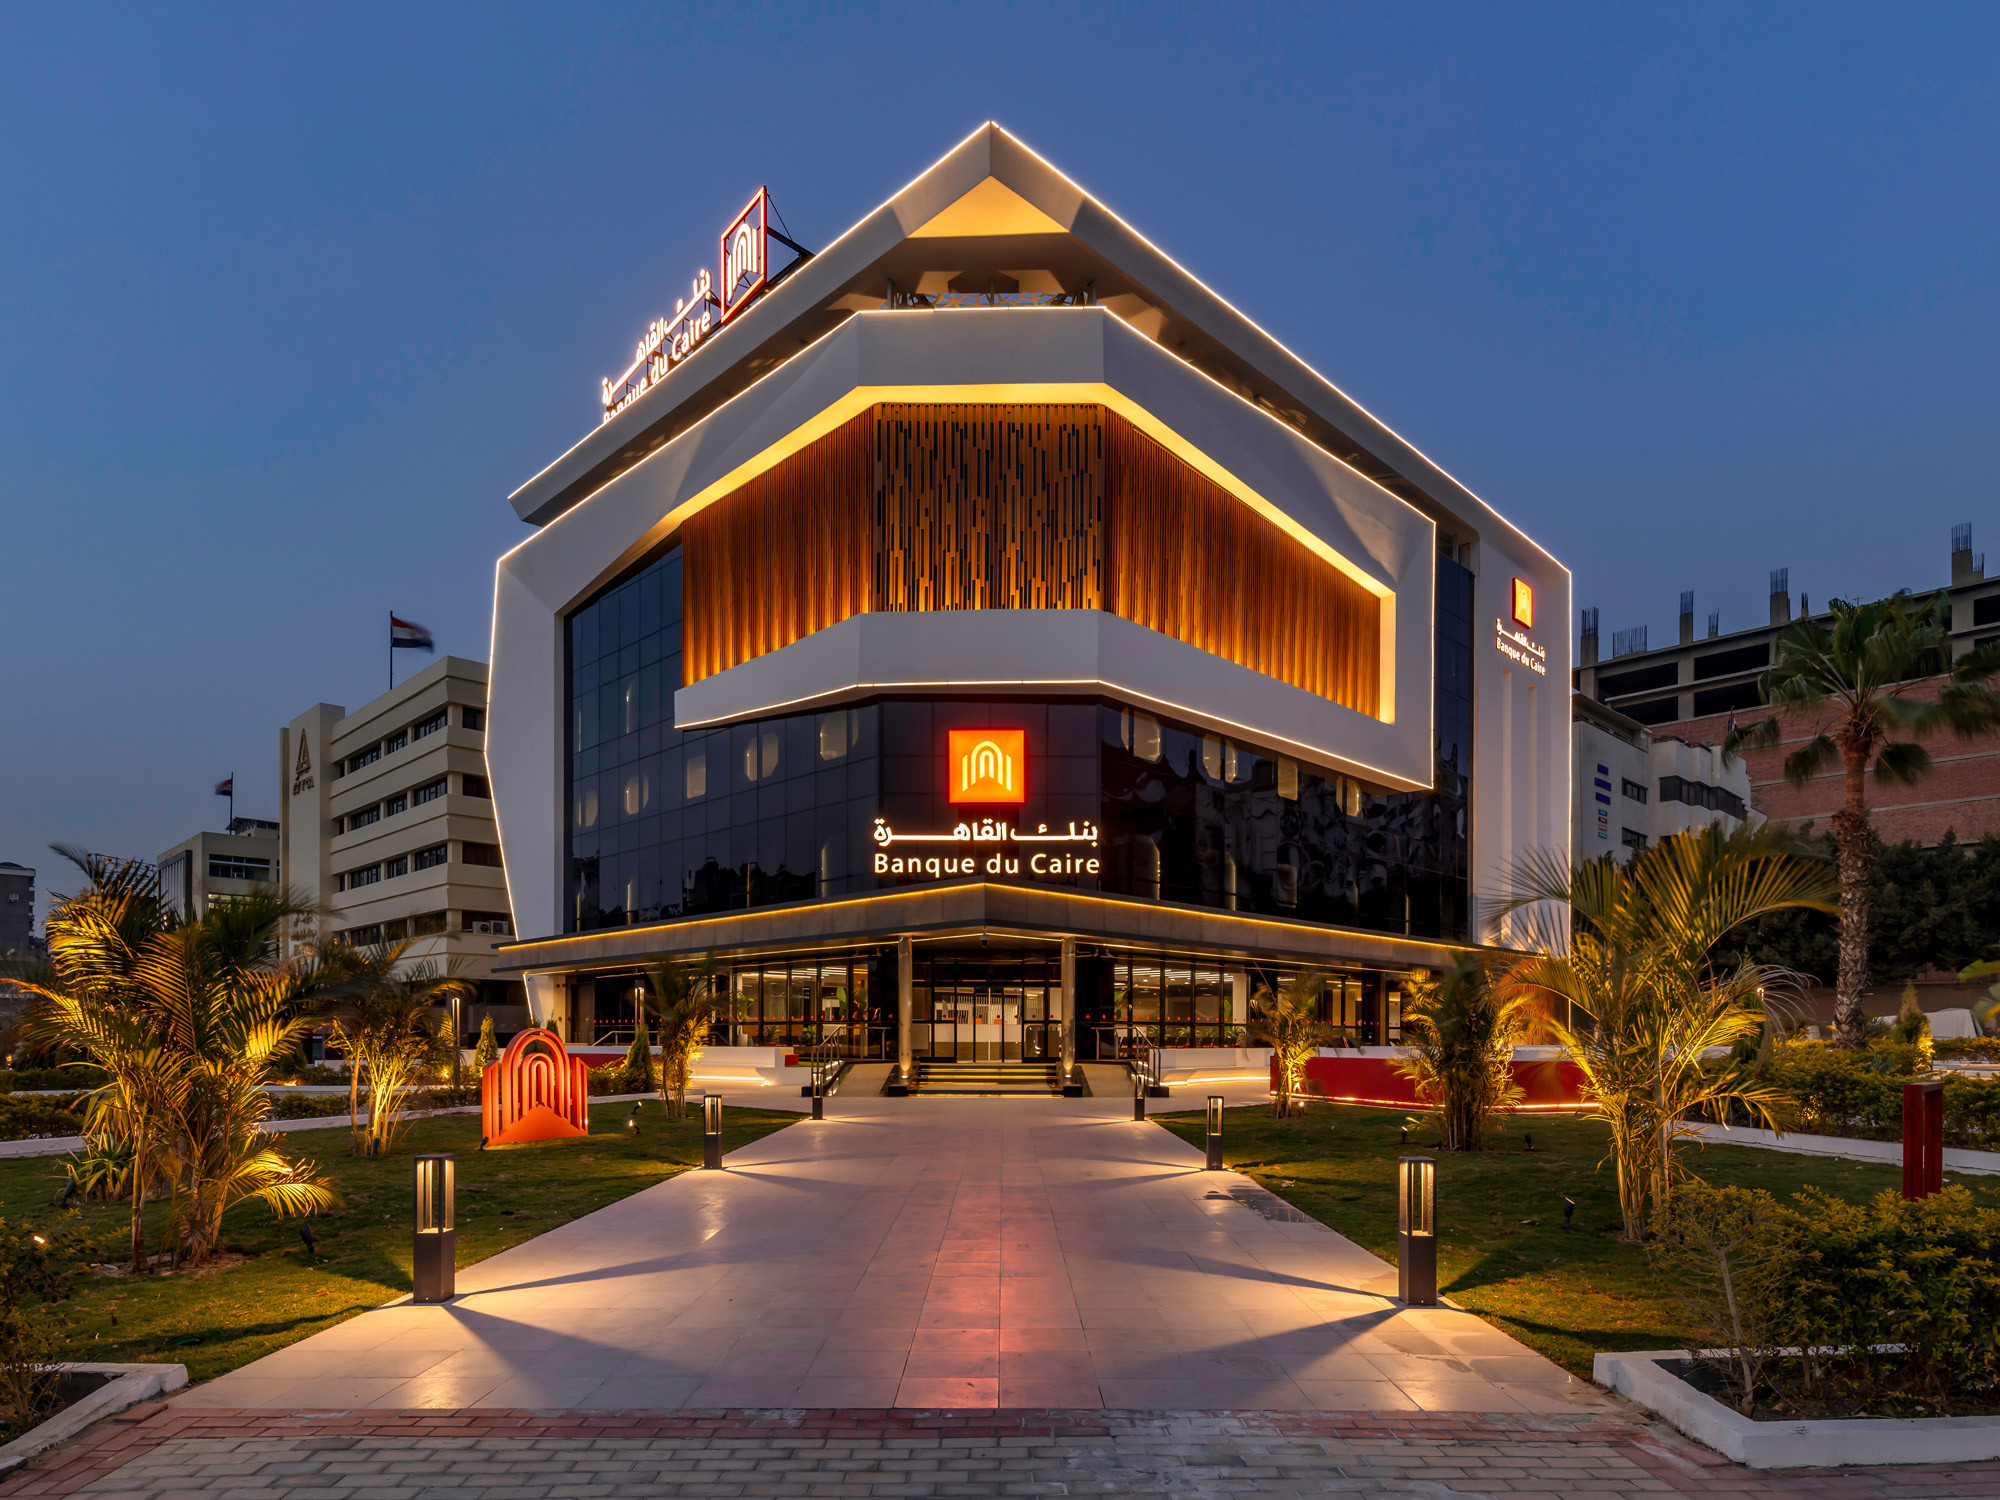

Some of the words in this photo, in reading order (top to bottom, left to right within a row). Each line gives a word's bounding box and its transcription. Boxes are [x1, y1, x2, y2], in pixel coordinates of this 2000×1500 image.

[650, 354, 668, 384] du
[672, 311, 711, 361] Caire
[1496, 637, 1521, 660] Banque
[1521, 652, 1530, 667] du
[1530, 658, 1546, 676] Caire
[873, 818, 1007, 847] القاهرة
[874, 853, 976, 878] Banque
[986, 853, 1019, 874] du
[1031, 853, 1101, 874] Caire
